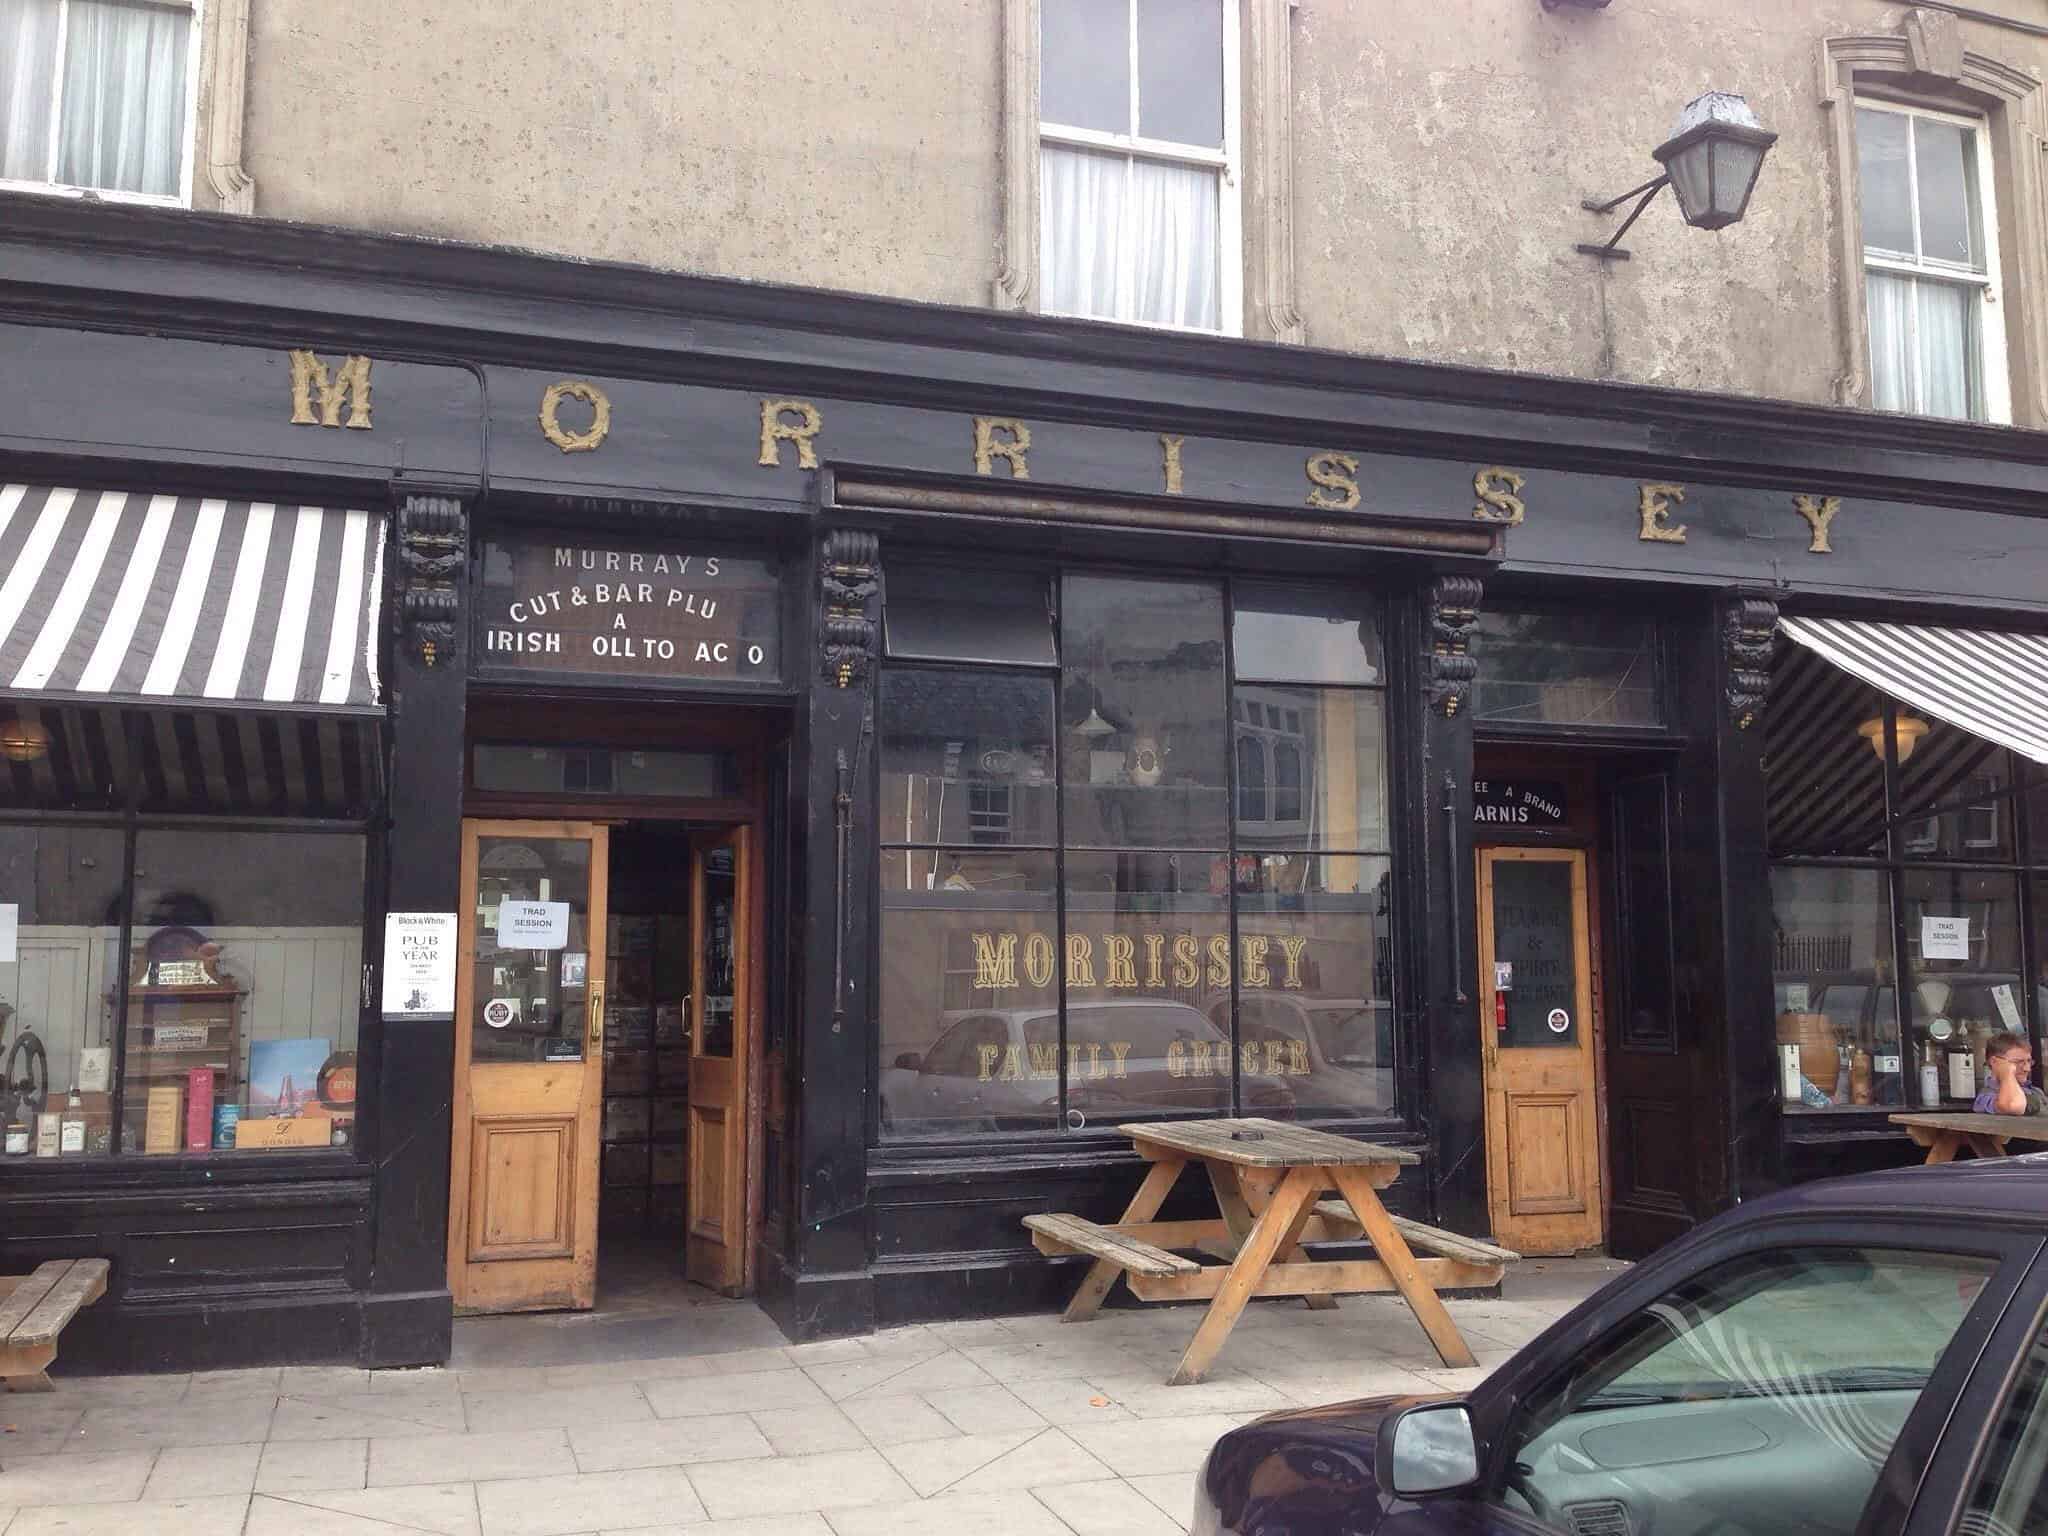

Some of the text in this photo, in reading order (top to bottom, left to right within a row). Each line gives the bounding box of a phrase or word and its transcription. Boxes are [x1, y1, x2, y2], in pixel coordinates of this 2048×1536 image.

[288, 348, 1842, 555] MORRISSEY
[509, 583, 717, 623] CUT & BAR PLU
[613, 613, 627, 630] A
[487, 630, 764, 665] IRISH OLL TO AC O
[1473, 804, 1529, 823] ARNIS
[1505, 786, 1513, 798] A
[1524, 791, 1561, 819] BRAND
[514, 918, 553, 928] SESSION
[522, 907, 546, 917] TRAD
[402, 935, 439, 946] PUB
[402, 950, 439, 961] YEAR
[972, 934, 1307, 988] MORRISSEY
[976, 1040, 1312, 1082] FAMILY GROCER
